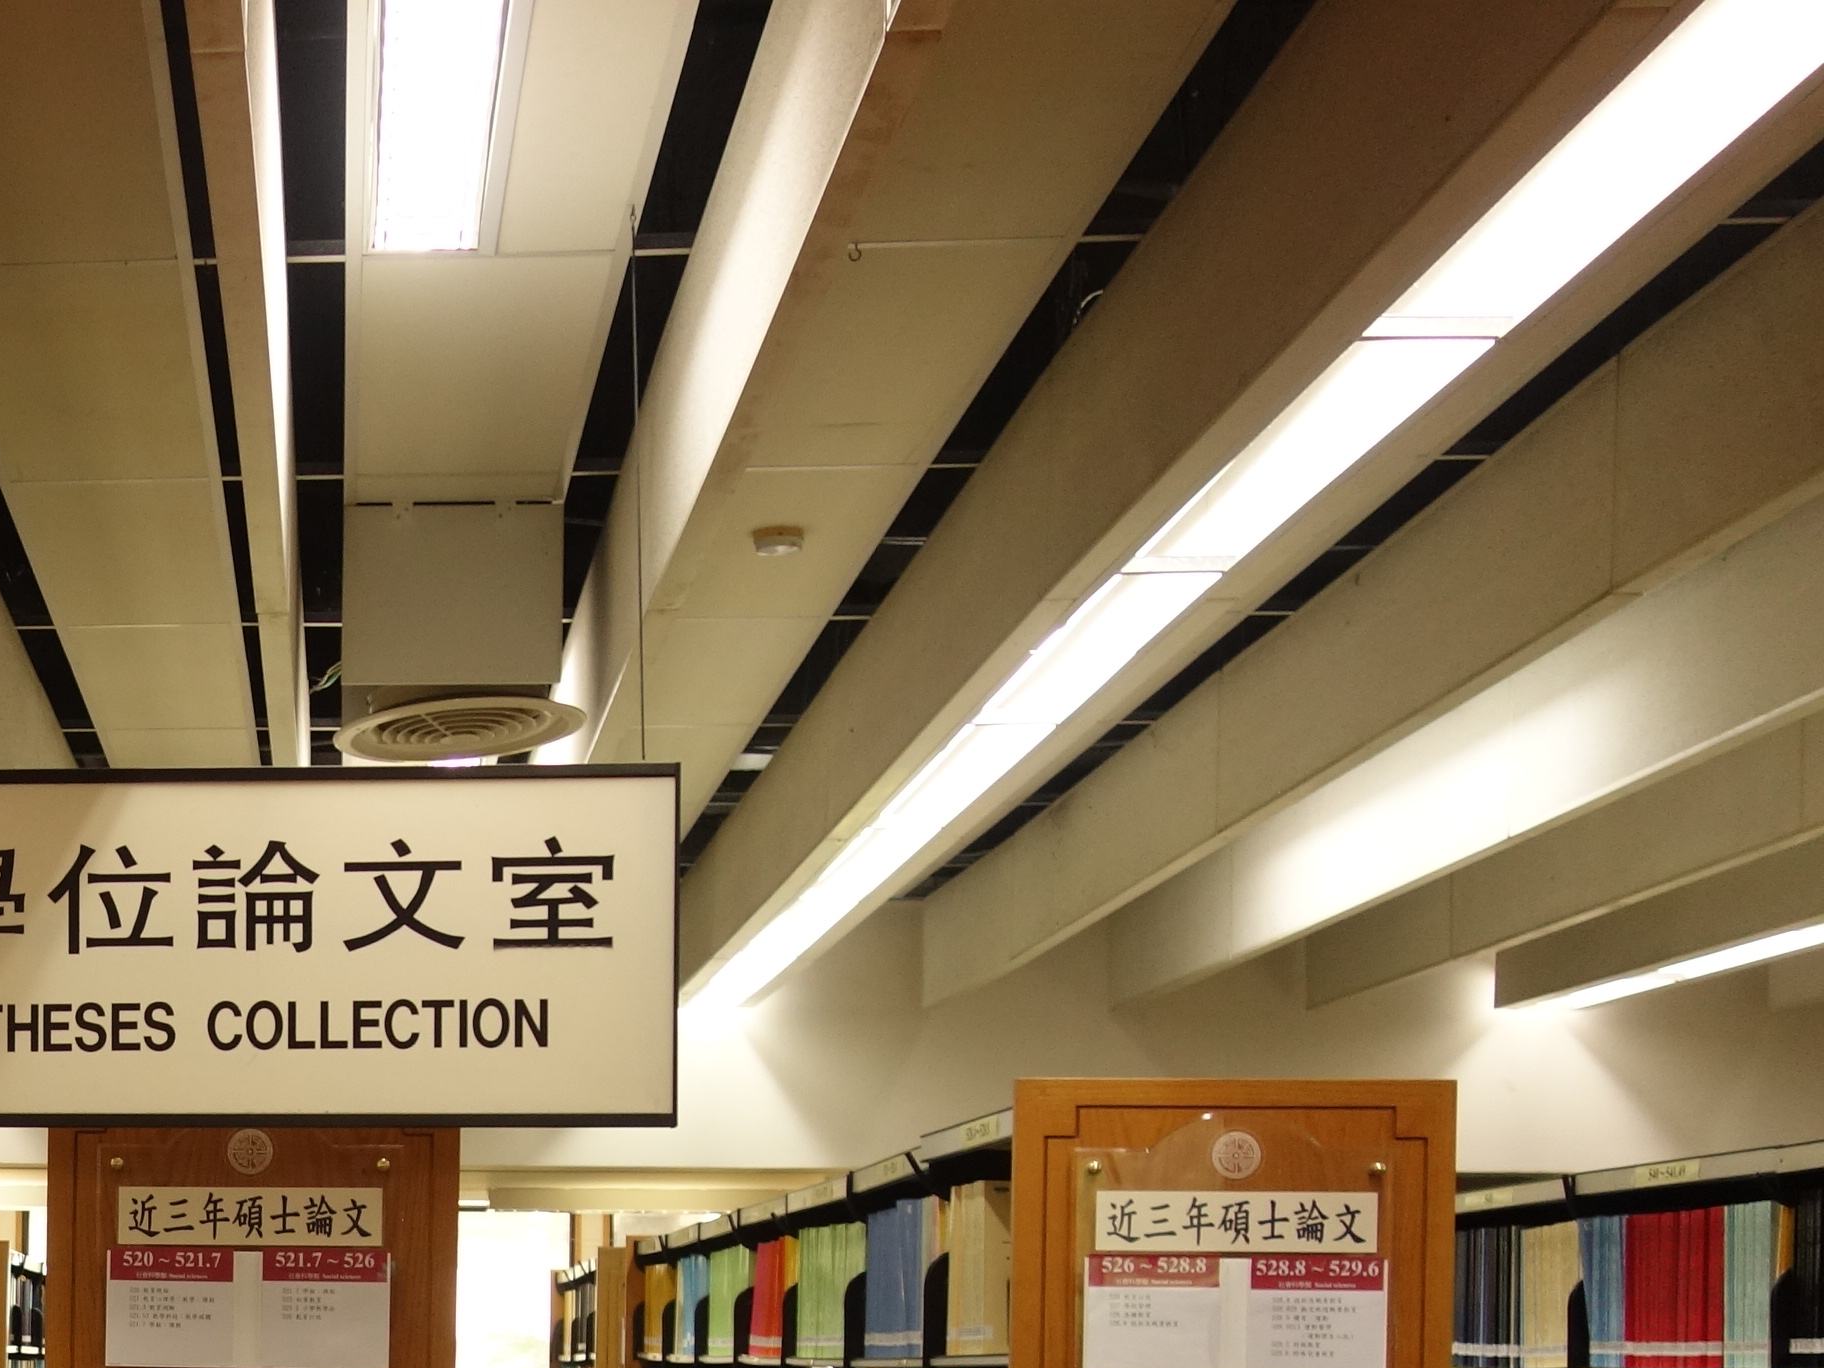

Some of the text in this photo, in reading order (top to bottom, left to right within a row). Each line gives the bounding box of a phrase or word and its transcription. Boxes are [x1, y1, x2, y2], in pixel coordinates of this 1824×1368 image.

[207, 998, 549, 1052] COLLECTION
[128, 1192, 373, 1241] 近三年碩士論文
[1107, 1197, 1367, 1246] 近三年碩士論文
[123, 1251, 154, 1267] 520
[175, 1251, 221, 1268] 521.7
[275, 1251, 322, 1268] 521.7
[343, 1252, 375, 1268] 526
[1102, 1256, 1135, 1273] 526
[1157, 1257, 1207, 1273] 528.8
[1256, 1259, 1306, 1276] 528.8
[1328, 1260, 1380, 1277] 529.6
